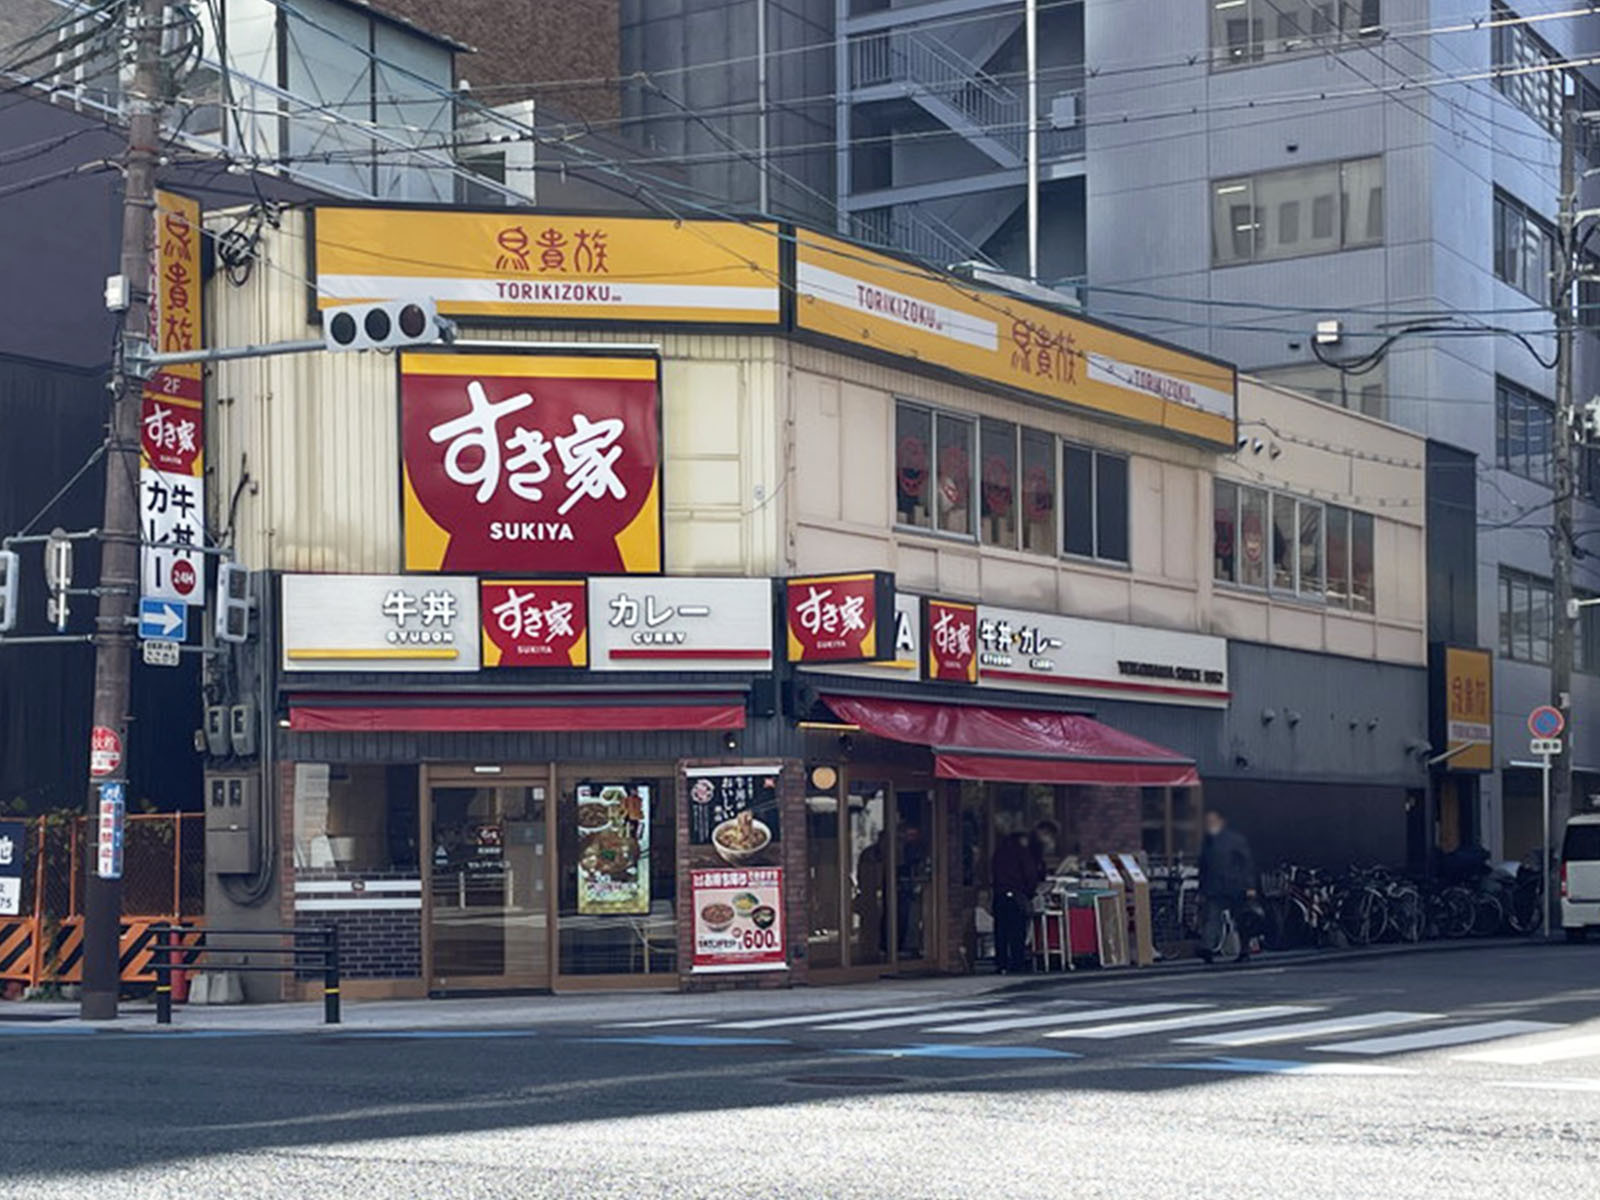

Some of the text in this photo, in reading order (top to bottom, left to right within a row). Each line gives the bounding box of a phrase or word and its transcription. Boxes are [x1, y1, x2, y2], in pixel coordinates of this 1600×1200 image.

[495, 225, 609, 272] 鳥貴族
[496, 282, 610, 301] TORIKIZOKU
[857, 285, 936, 324] TORIKIZOKU
[163, 376, 180, 394] 2F
[145, 403, 196, 455] すき家
[429, 380, 627, 516] すき家
[147, 481, 169, 588] カレー
[172, 484, 195, 558] 牛丼
[490, 522, 574, 540] SUKIYA
[383, 590, 457, 627] 牛丼
[492, 587, 574, 643] すき家
[608, 593, 711, 627] カレー
[796, 587, 865, 637] すき家
[385, 630, 455, 644] GYUDON
[631, 631, 687, 645] CURRY
[933, 608, 971, 659] すき家
[743, 929, 774, 950] 600
